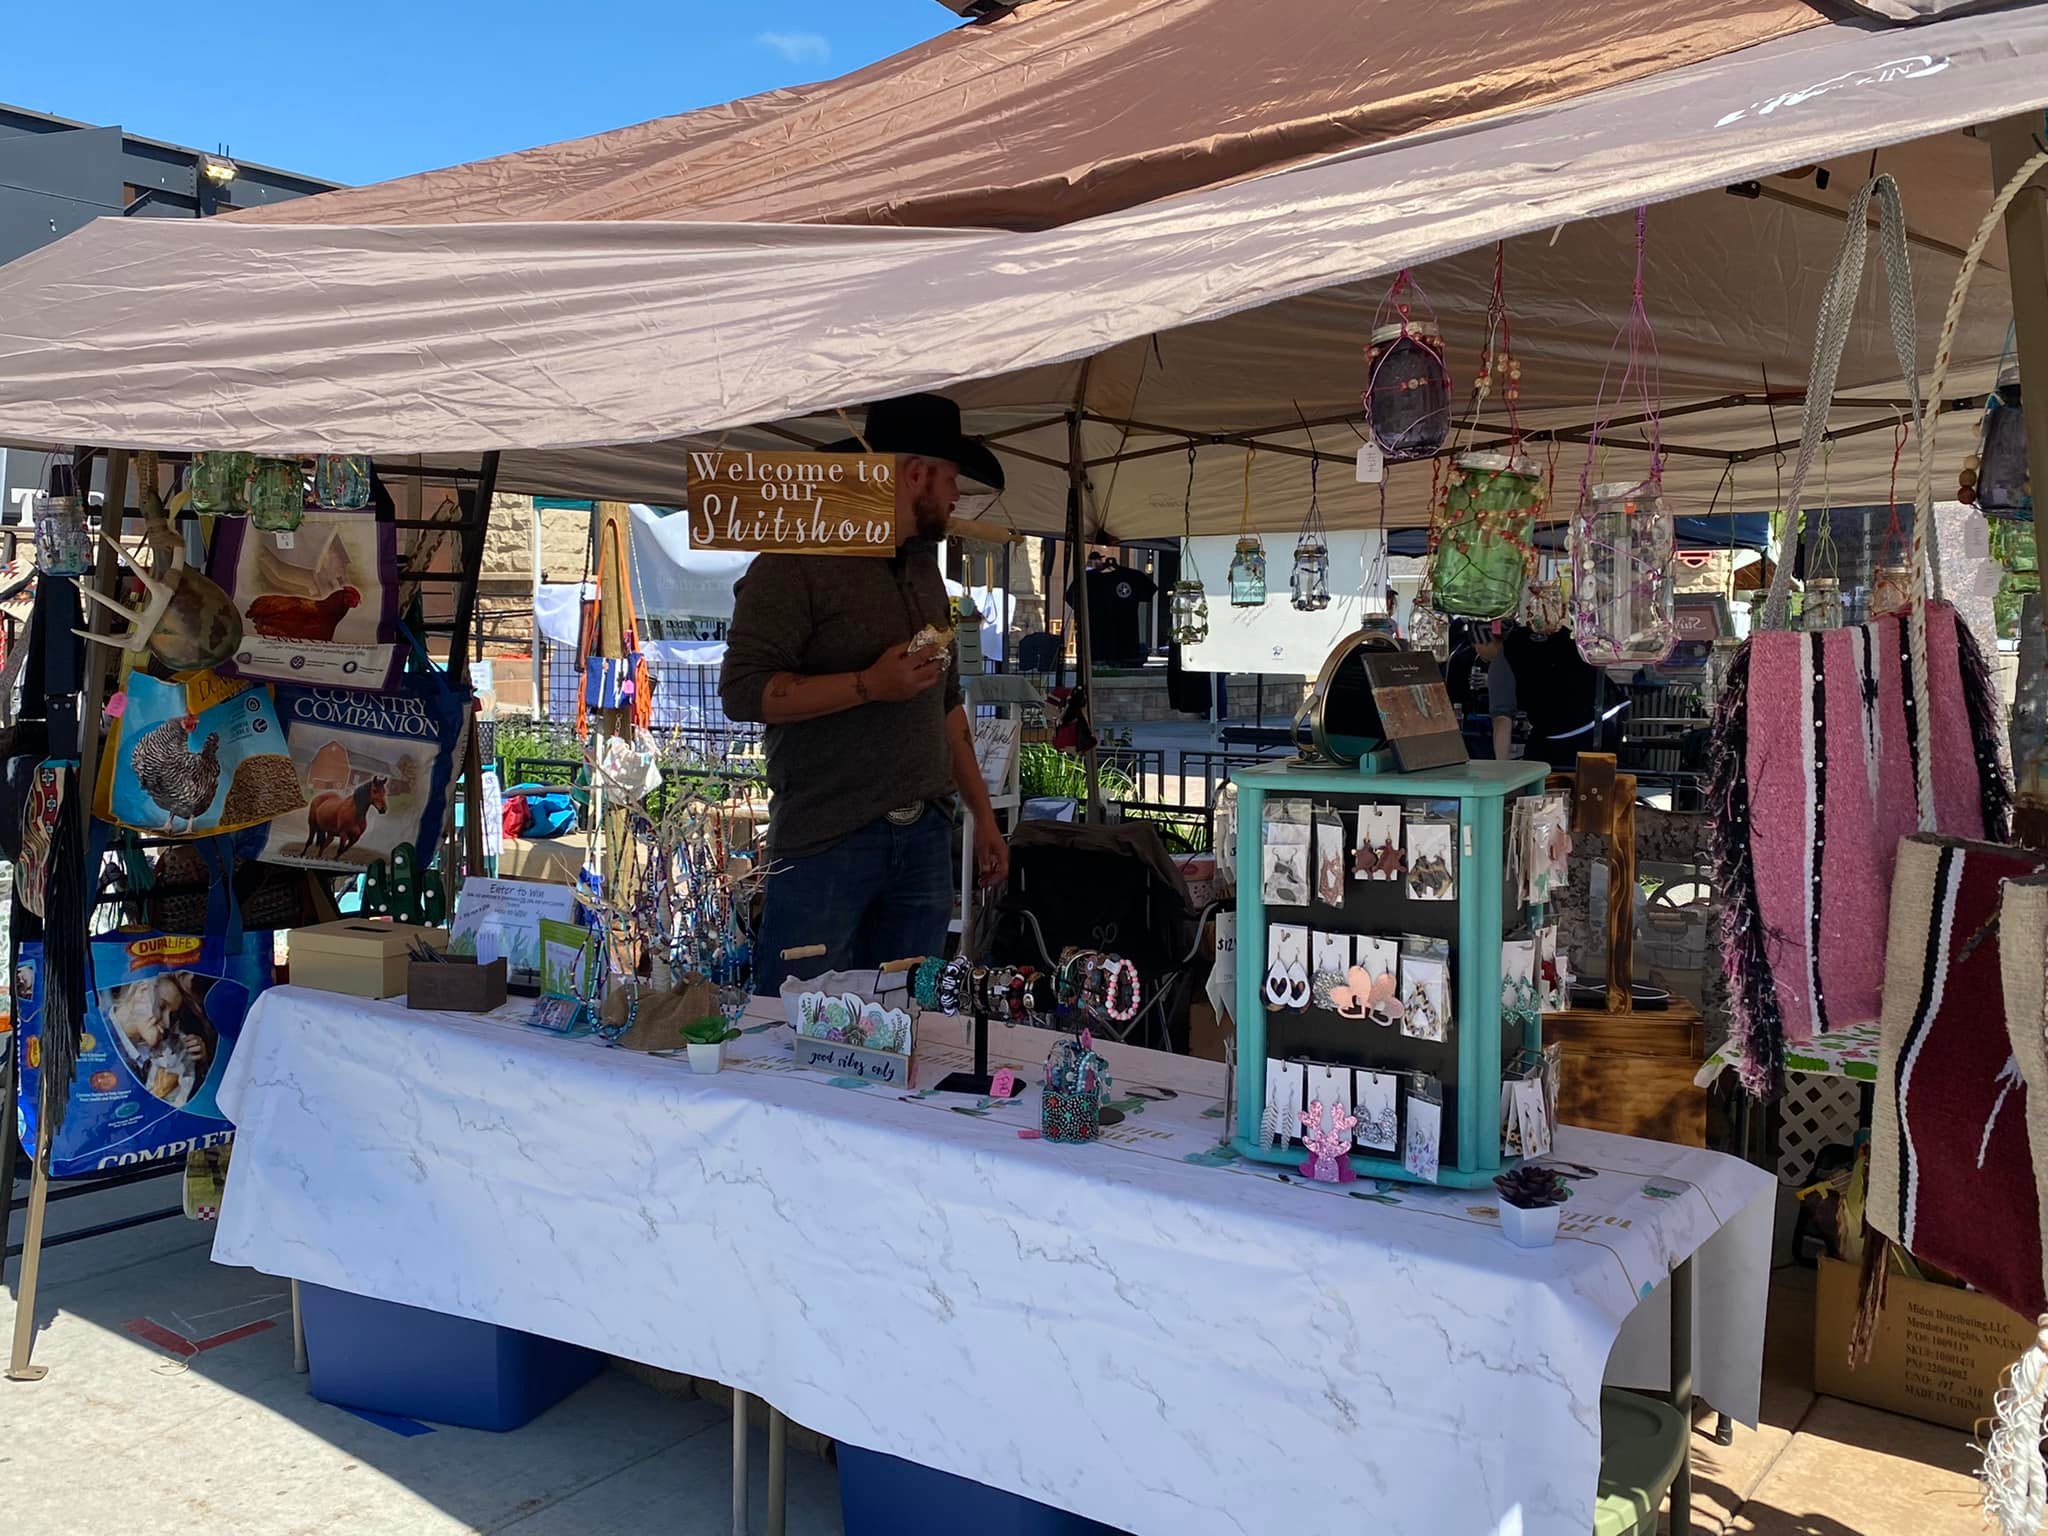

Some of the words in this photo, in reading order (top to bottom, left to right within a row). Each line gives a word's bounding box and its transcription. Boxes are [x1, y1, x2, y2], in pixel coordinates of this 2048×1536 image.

[690, 452, 844, 482] Welcome
[856, 460, 890, 482] to
[760, 482, 817, 501] our
[693, 494, 890, 544] Shitshow
[294, 697, 440, 737] COMPANION
[312, 688, 427, 717] COUNTRY
[489, 884, 513, 895] Enter
[517, 887, 527, 897] to
[1217, 937, 1237, 952] $12
[808, 1050, 834, 1064] good
[837, 1052, 866, 1076] vibes
[871, 1061, 895, 1082] only
[1905, 1384, 1934, 1399] MADE
[1936, 1392, 1948, 1404] IN
[1949, 1395, 1982, 1411] CHINA
